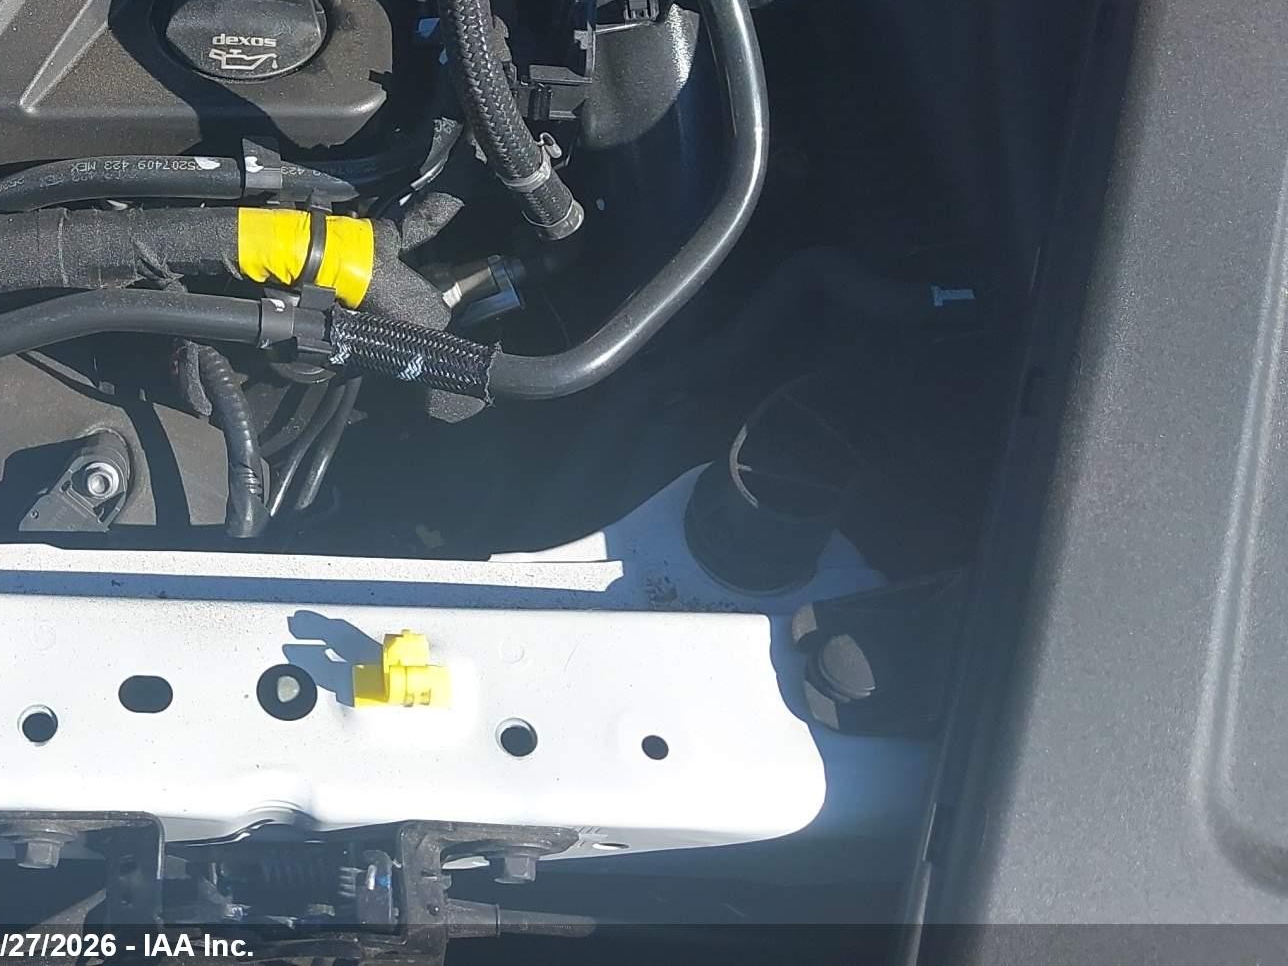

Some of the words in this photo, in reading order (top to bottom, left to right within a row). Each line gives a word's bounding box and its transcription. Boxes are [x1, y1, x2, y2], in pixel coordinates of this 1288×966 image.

[212, 33, 277, 47] dexos
[70, 161, 96, 172] MEX
[103, 160, 129, 171] 423
